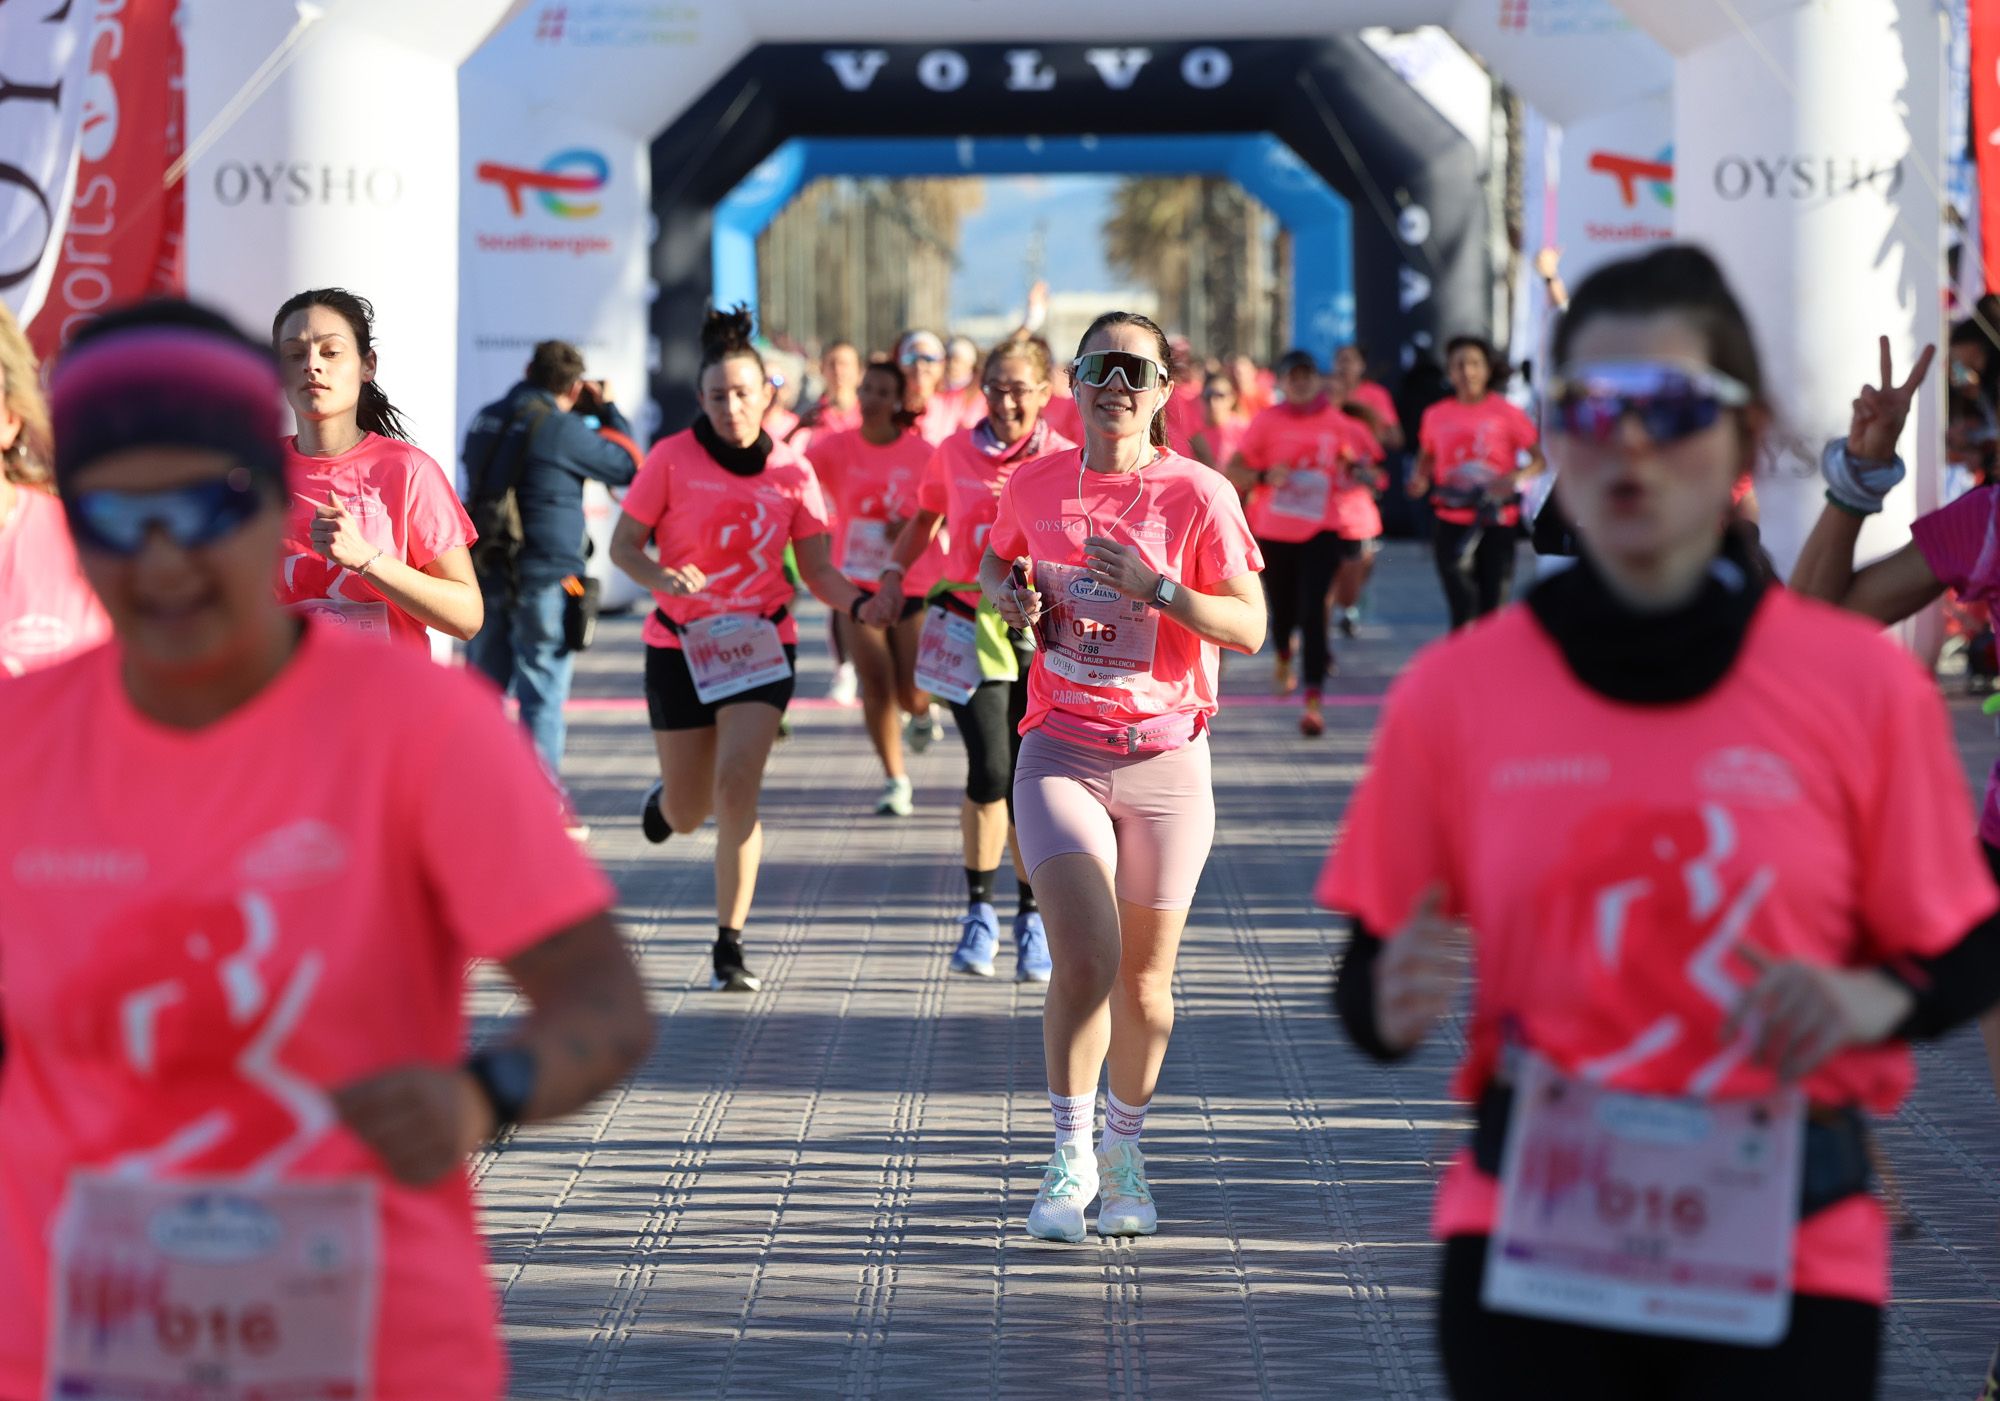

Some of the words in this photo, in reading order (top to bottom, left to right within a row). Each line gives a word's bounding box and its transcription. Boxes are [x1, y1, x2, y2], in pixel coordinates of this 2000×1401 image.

[823, 46, 1232, 92] VOLVO
[214, 161, 402, 206] OYSHO
[1714, 155, 1904, 201] OYSHO
[1035, 519, 1085, 533] OYSHO
[1072, 583, 1118, 600] ASTURIANA
[1072, 619, 1118, 642] 016
[719, 641, 755, 663] 016
[1083, 656, 1104, 665] MUJER
[1108, 659, 1136, 668] VALENCIA
[1098, 672, 1136, 684] Santader
[1597, 1183, 1710, 1237] 016
[156, 1302, 282, 1358] 016
